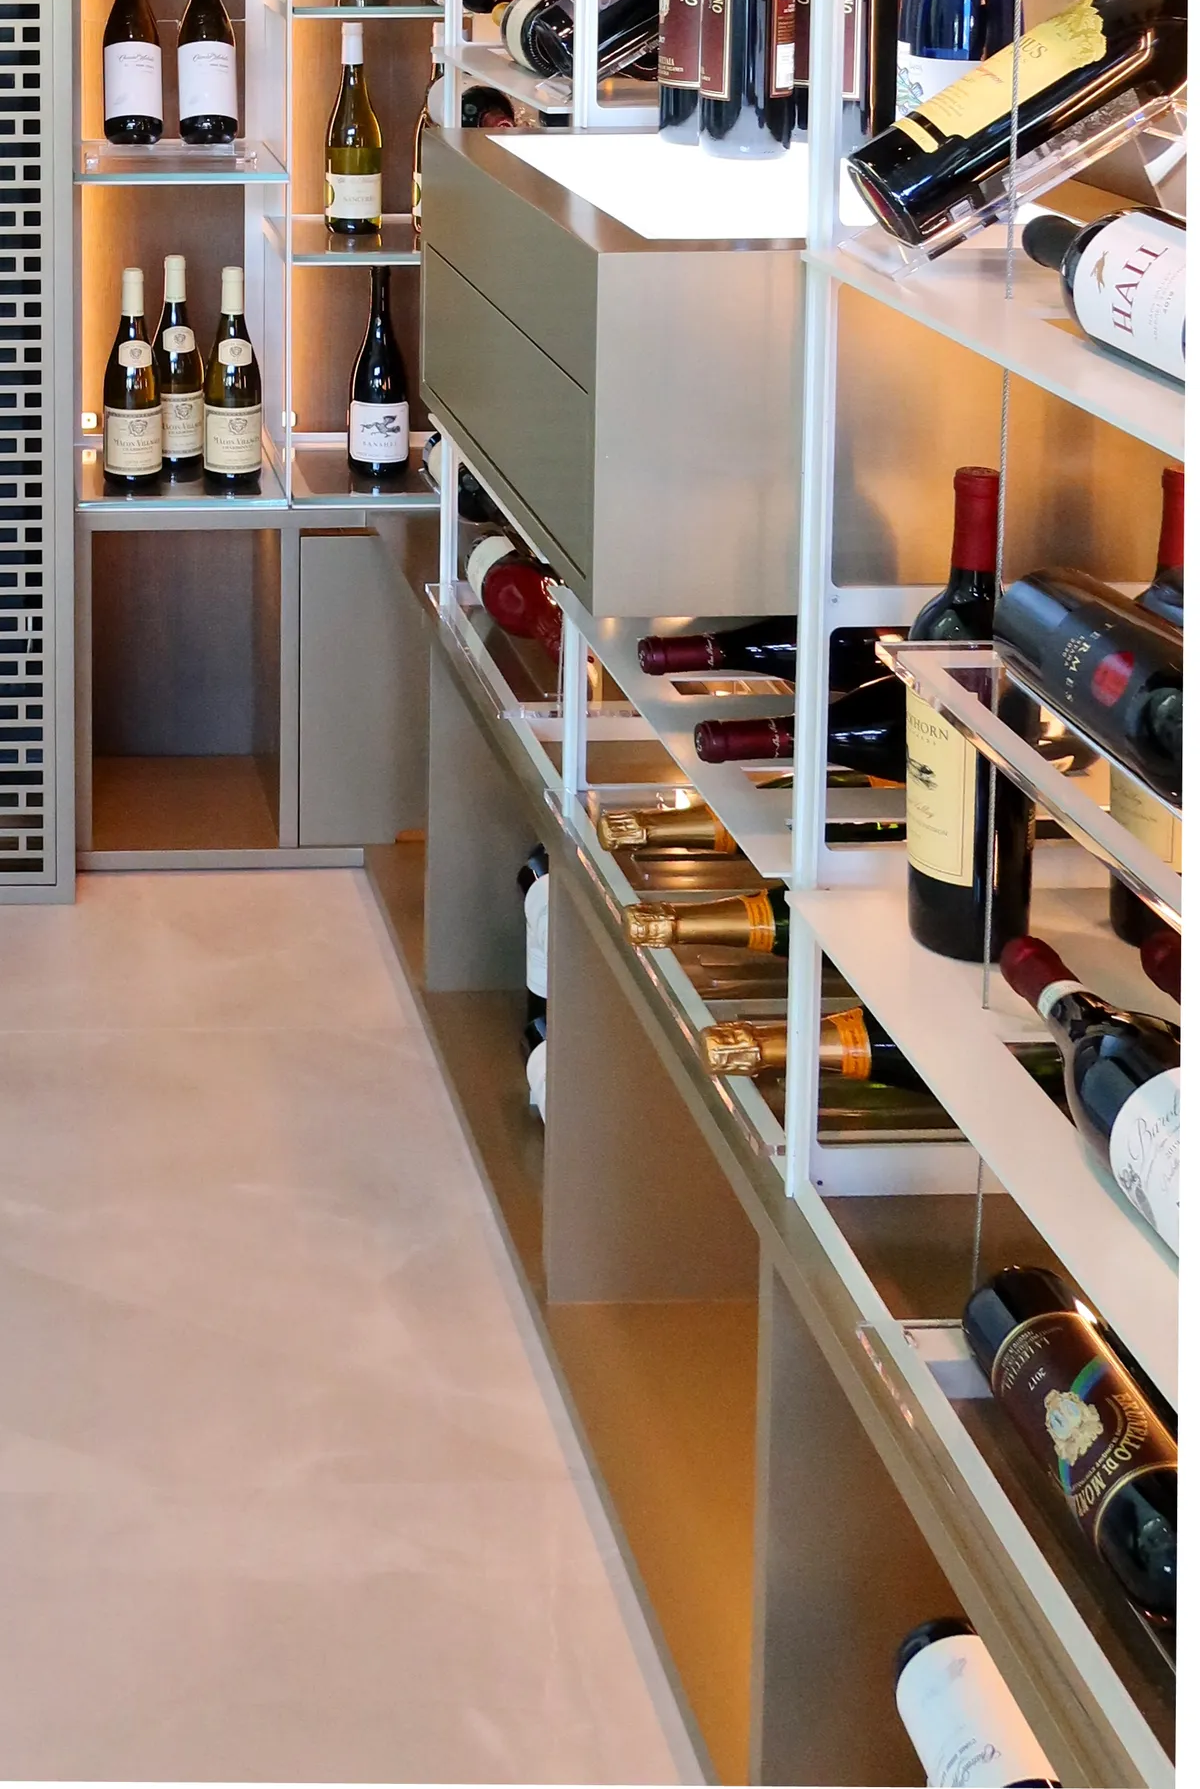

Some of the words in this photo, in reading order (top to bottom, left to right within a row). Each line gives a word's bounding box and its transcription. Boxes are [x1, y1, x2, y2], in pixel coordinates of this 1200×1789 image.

[1112, 244, 1169, 337] HALL
[907, 712, 949, 741] KHORN
[1128, 1087, 1181, 1162] Barol
[1027, 1367, 1047, 1391] 2017
[1102, 1457, 1119, 1475] DI
